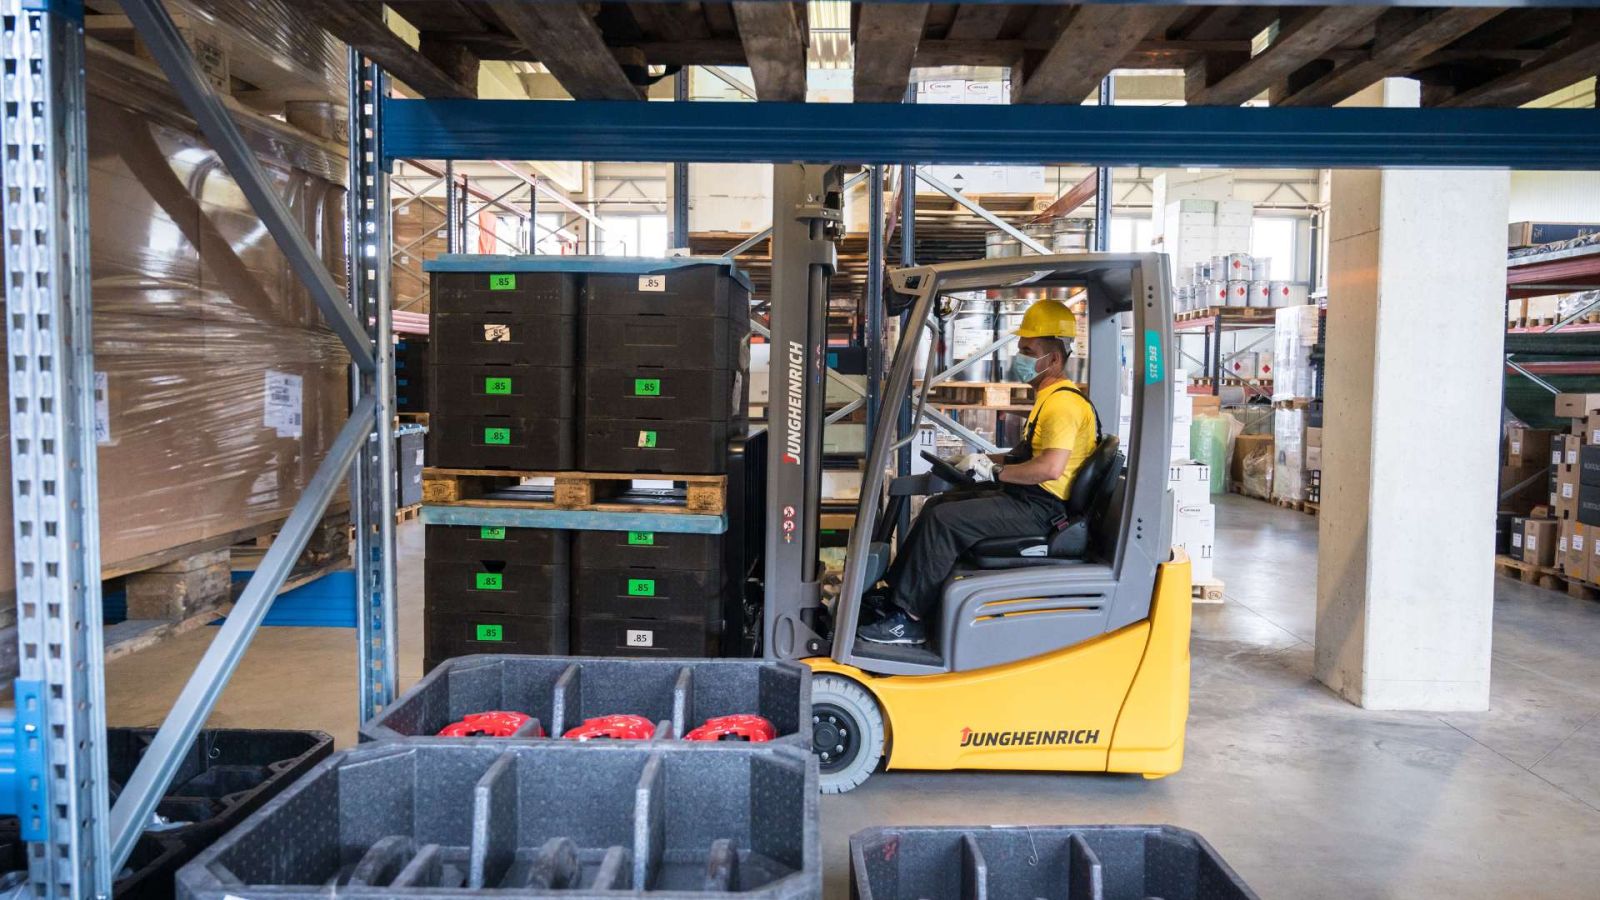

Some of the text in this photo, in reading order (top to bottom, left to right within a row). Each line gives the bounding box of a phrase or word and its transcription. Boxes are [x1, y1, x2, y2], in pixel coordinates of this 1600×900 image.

[496, 278, 510, 286] .85
[645, 279, 659, 287] .85
[1149, 345, 1158, 379] EFG 215
[491, 382, 505, 391] .85
[641, 384, 655, 392] .85
[785, 341, 804, 465] JUNGHEINRICH
[491, 432, 505, 440] .85
[634, 532, 648, 541] .85
[483, 577, 497, 585] .85
[635, 583, 649, 592] .85
[483, 629, 497, 637] .85
[633, 634, 647, 642] .85
[960, 728, 1100, 747] JUNGHEINRICH
